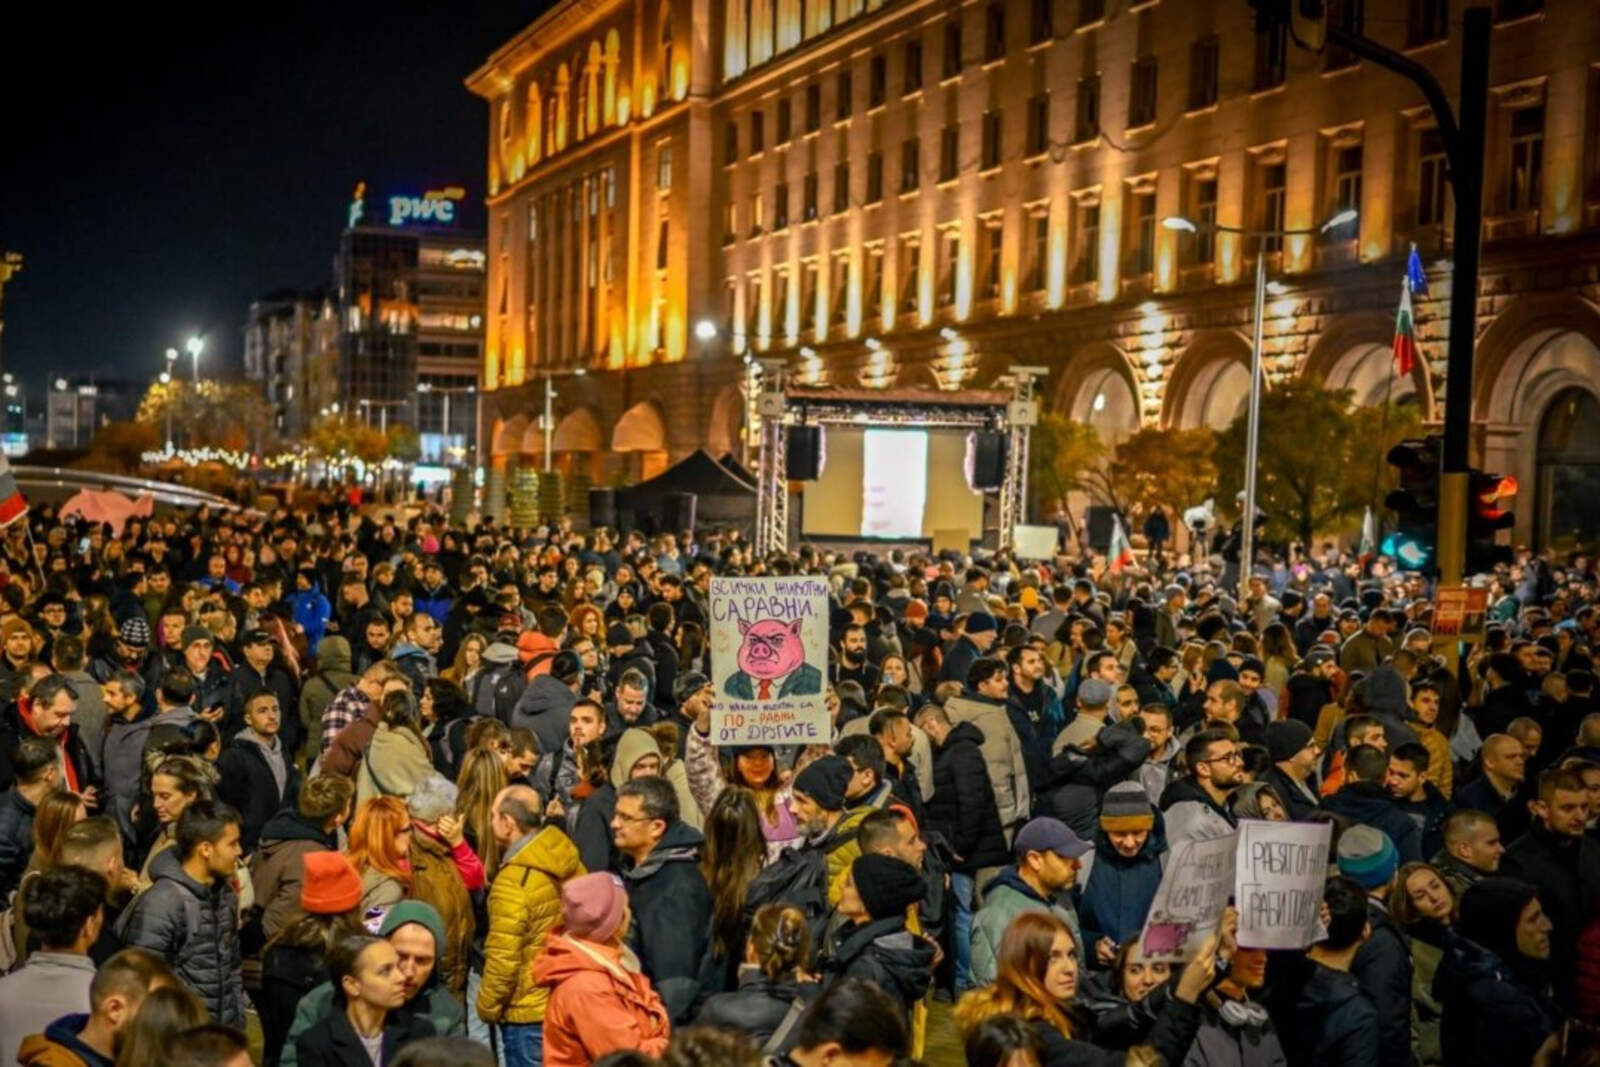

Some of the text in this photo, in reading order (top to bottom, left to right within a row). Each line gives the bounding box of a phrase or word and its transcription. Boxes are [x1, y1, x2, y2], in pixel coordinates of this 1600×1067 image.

[389, 196, 454, 225] pwc
[711, 579, 768, 596] ВСИЧКИ
[719, 722, 818, 741] ОТ ДРУГИТЕ
